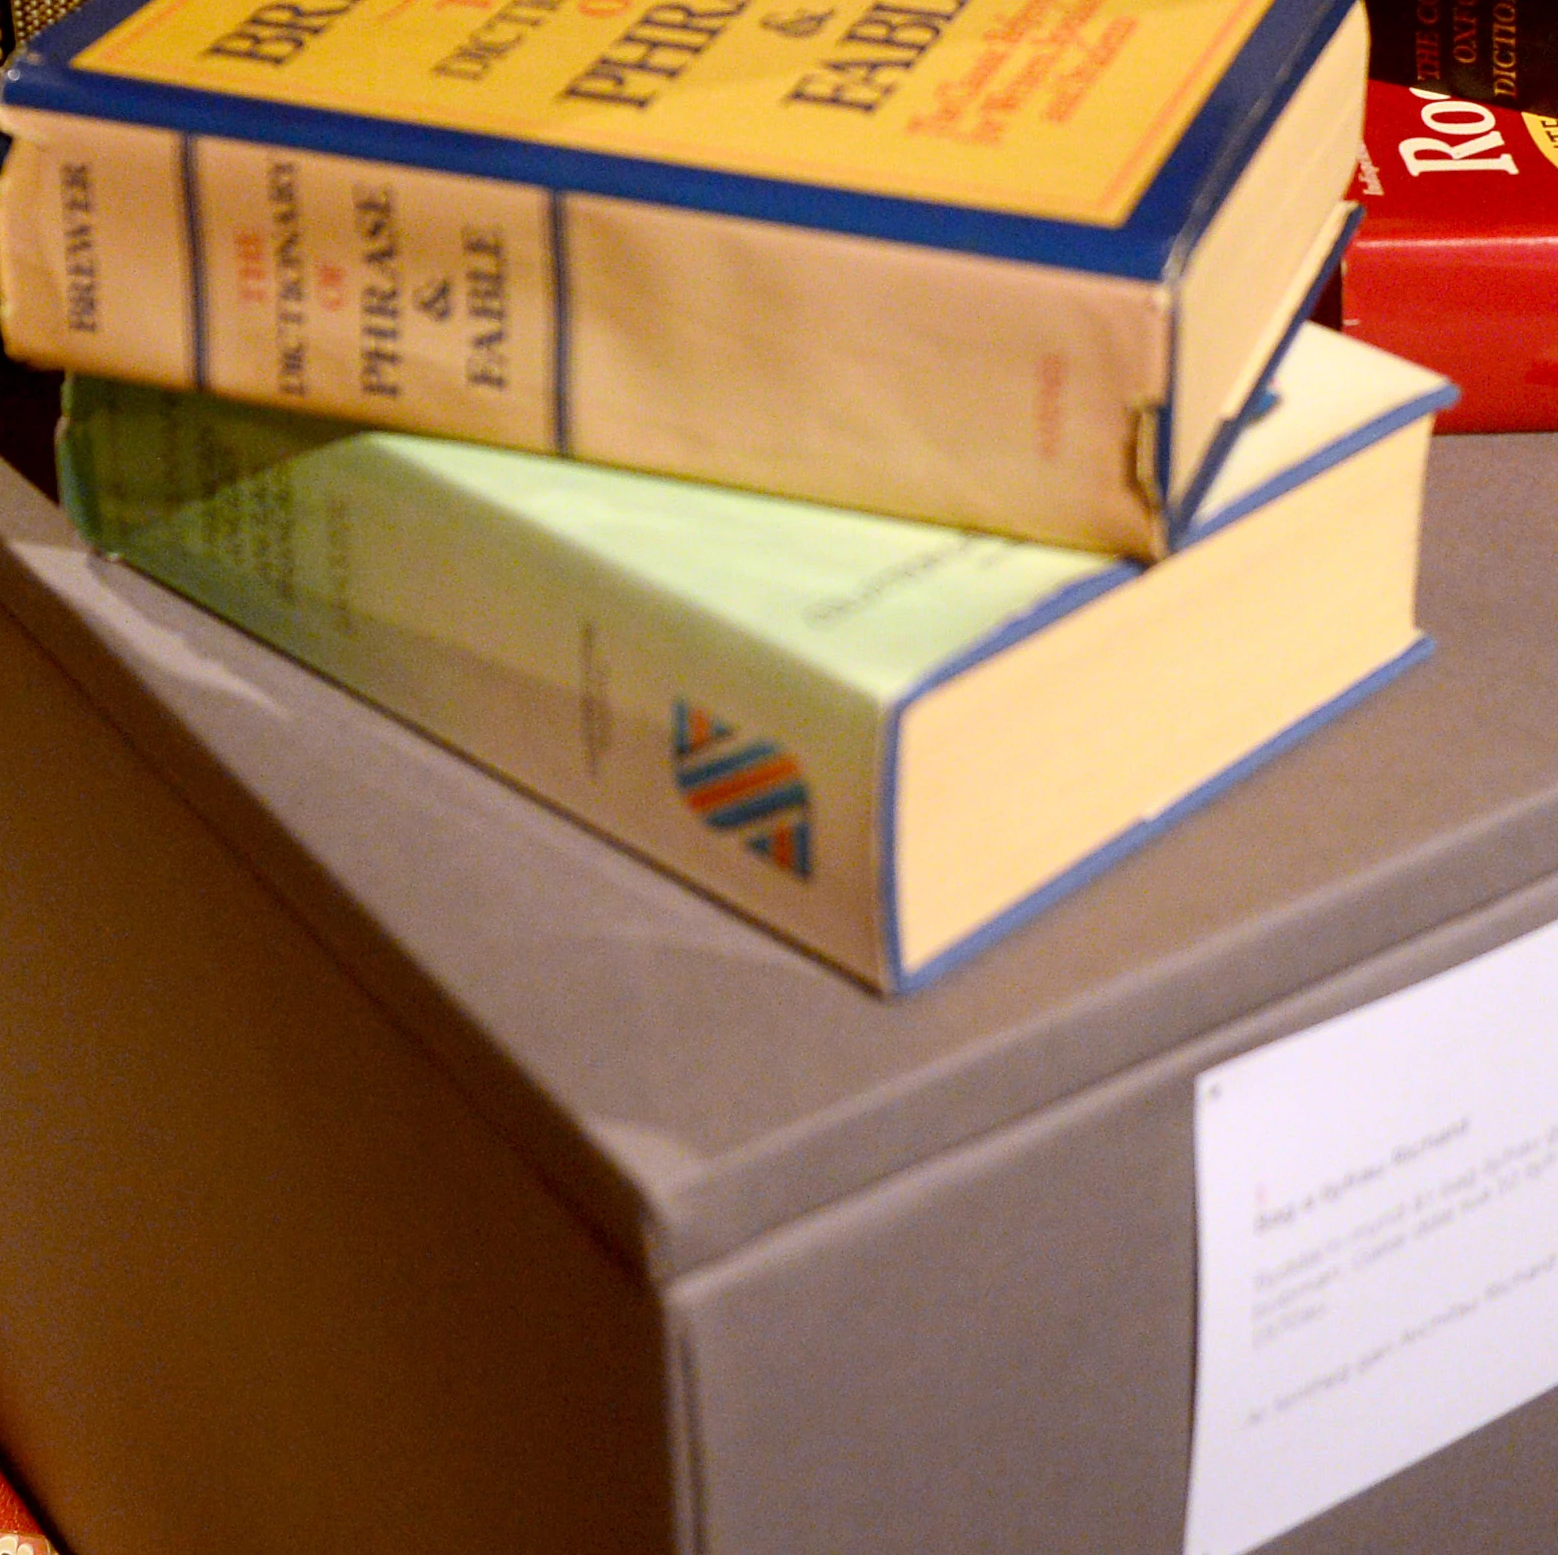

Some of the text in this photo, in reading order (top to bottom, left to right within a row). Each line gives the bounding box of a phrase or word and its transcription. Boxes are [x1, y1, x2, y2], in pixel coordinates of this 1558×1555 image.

[759, 6, 835, 37] &
[1416, 30, 1440, 80] THE
[1399, 88, 1519, 176] Ro
[61, 162, 97, 333] BREWER
[235, 230, 264, 304] THE
[267, 158, 306, 399] DICTIONARY
[352, 182, 399, 400] PHRASE
[415, 281, 451, 321] &
[462, 226, 507, 393] FABLE
